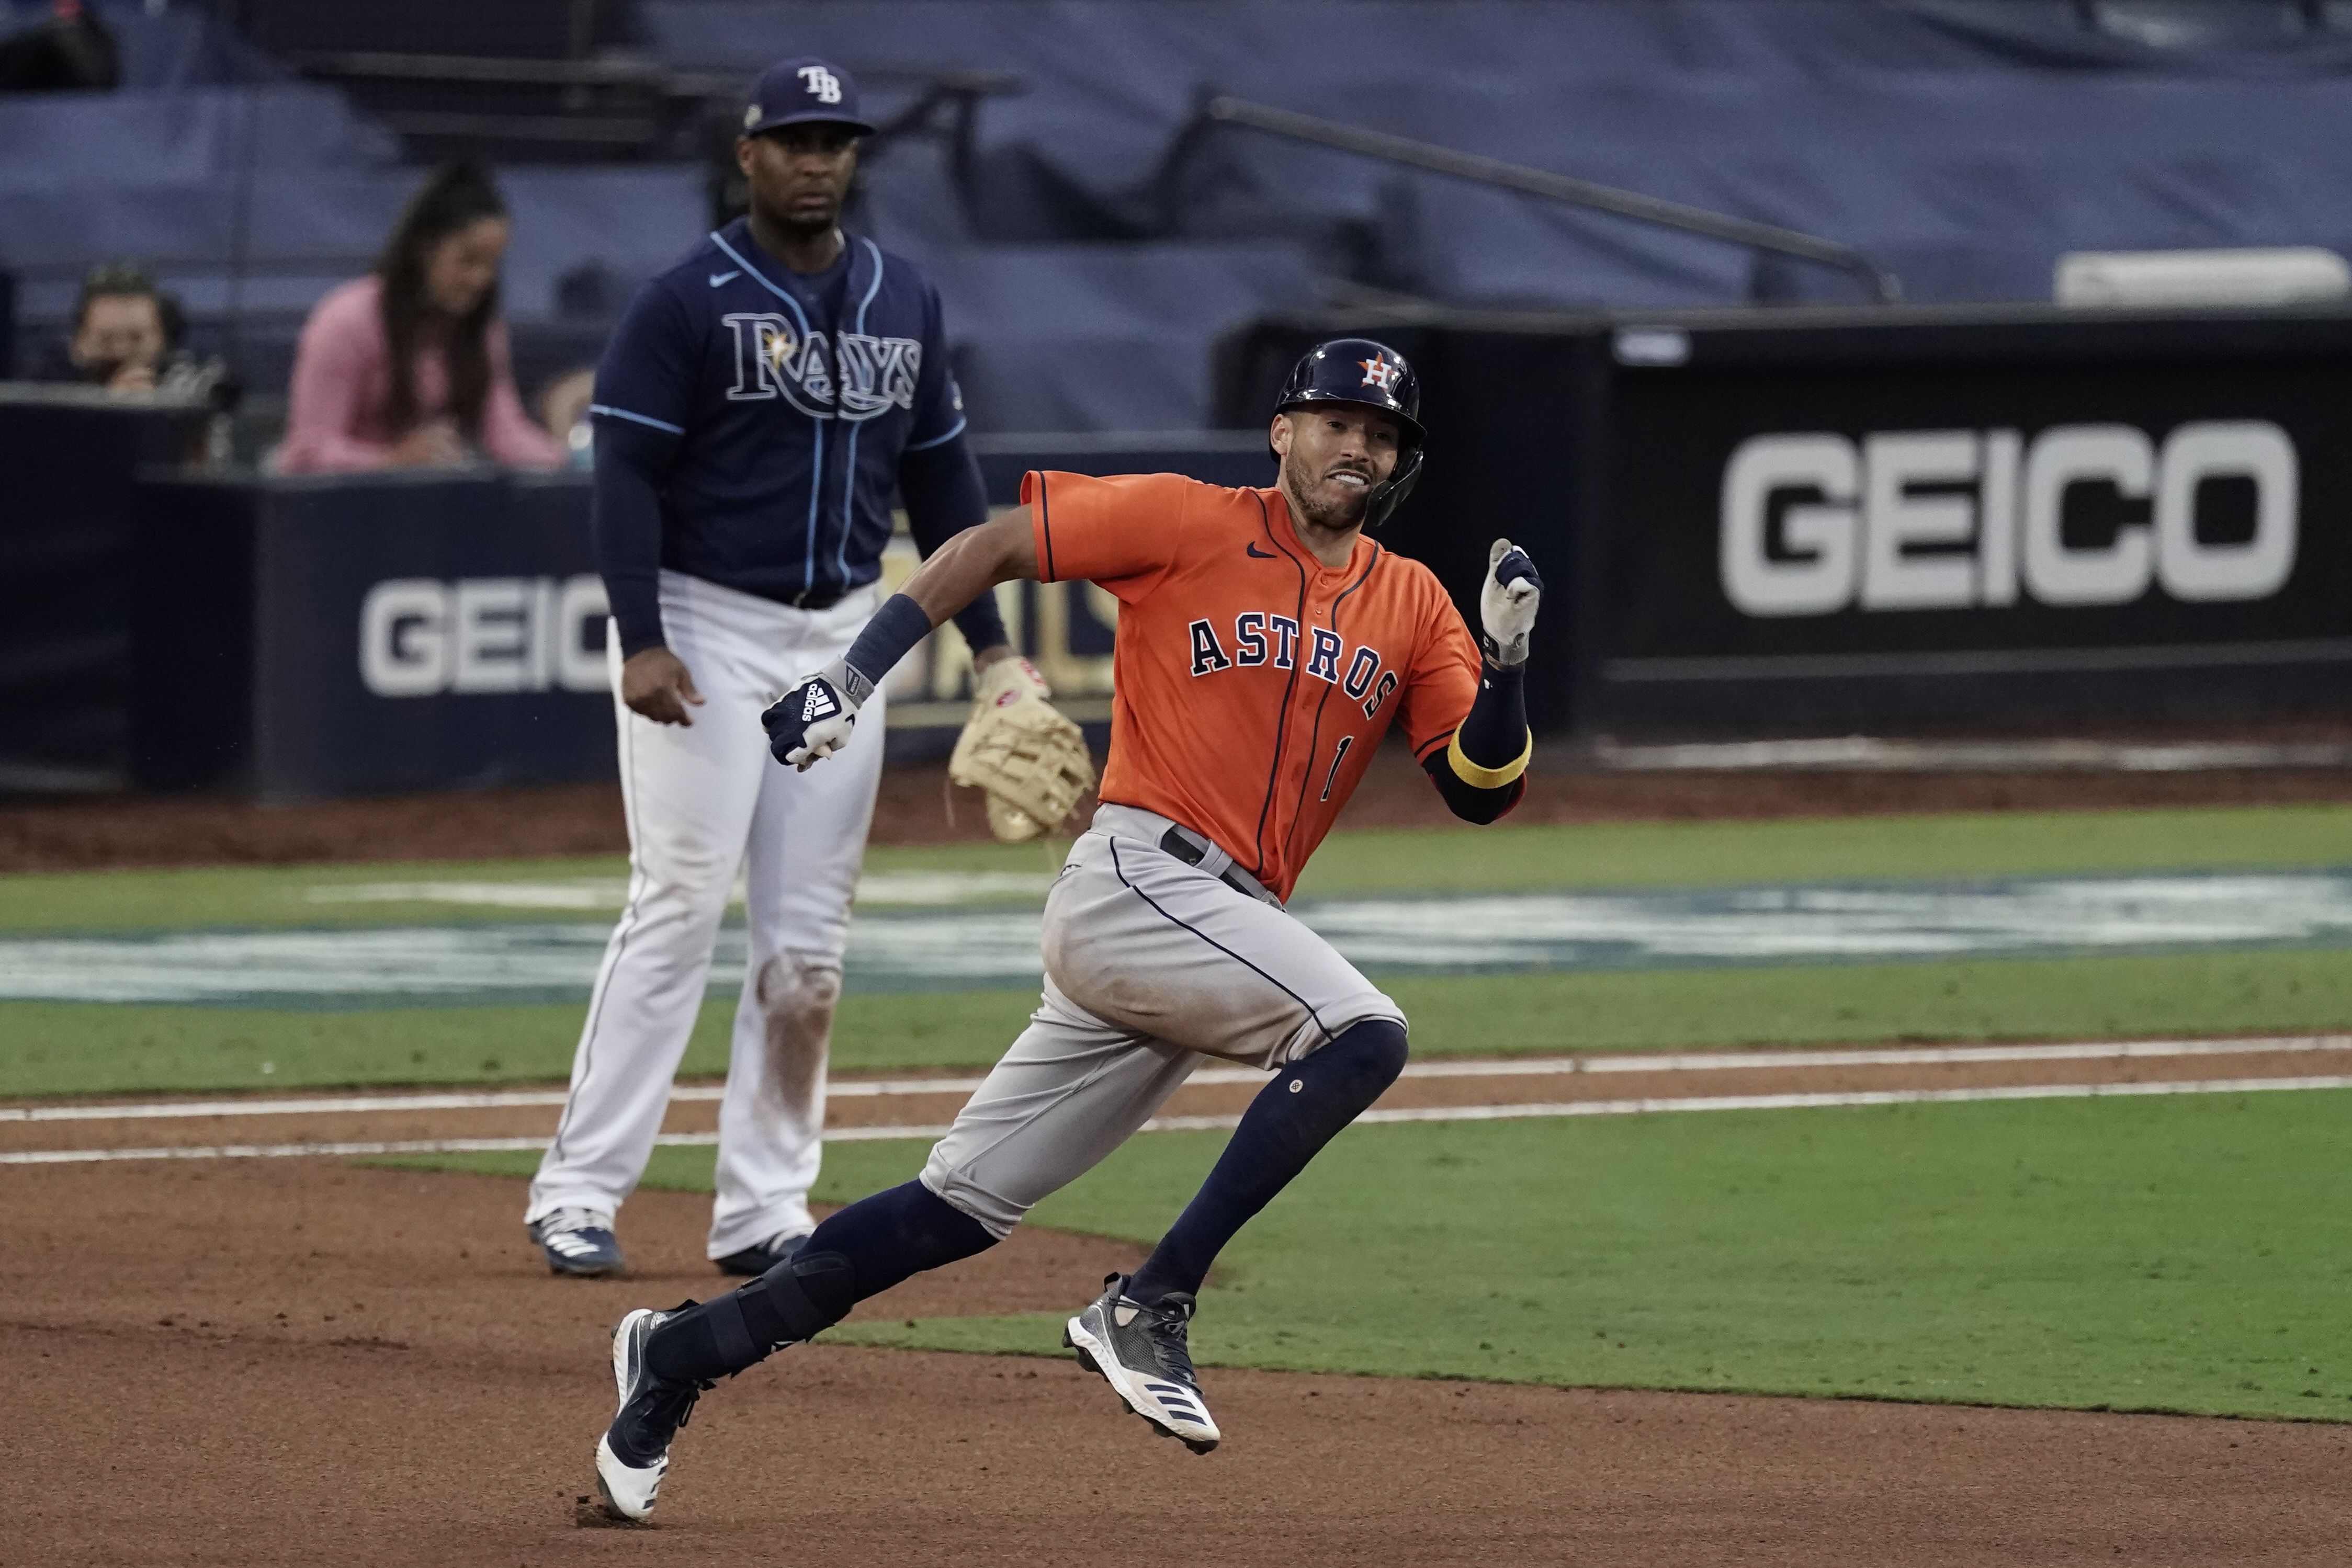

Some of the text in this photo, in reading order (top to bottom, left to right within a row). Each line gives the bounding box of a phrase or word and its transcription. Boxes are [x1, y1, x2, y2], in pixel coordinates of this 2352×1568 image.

[798, 66, 841, 104] TB
[1363, 359, 1392, 389] H
[1721, 420, 2298, 617] GEICO
[361, 574, 612, 696] GEIC
[1189, 611, 1398, 721] ASTROS
[802, 684, 818, 721] adidas
[1320, 735, 1354, 802] 1
